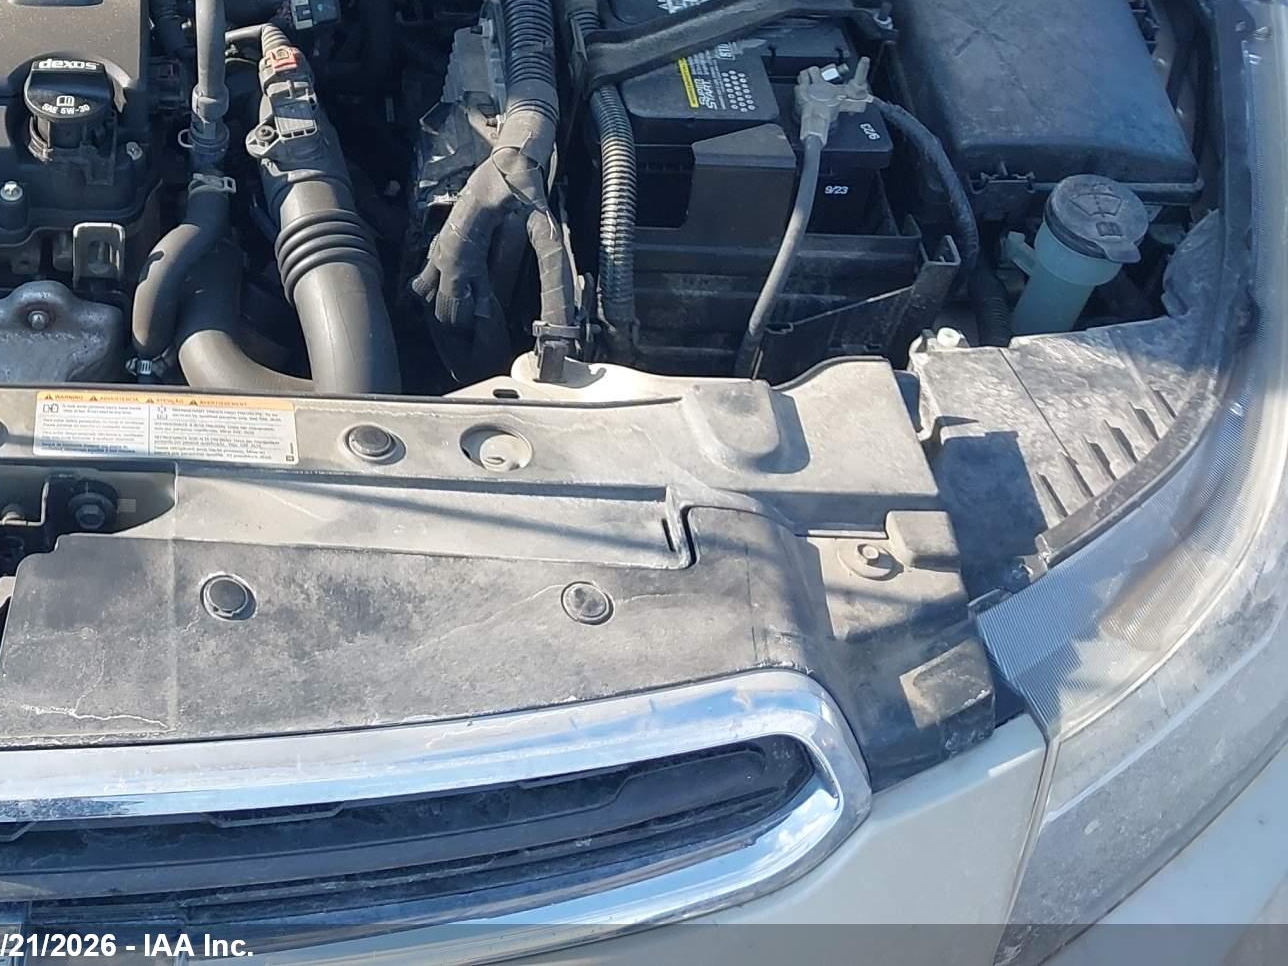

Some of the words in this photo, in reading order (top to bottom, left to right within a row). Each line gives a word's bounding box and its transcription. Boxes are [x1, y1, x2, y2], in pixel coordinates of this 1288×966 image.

[38, 58, 97, 70] dexos
[41, 103, 58, 114] SAE
[60, 104, 91, 115] 5W-30
[824, 185, 849, 195] 9/23
